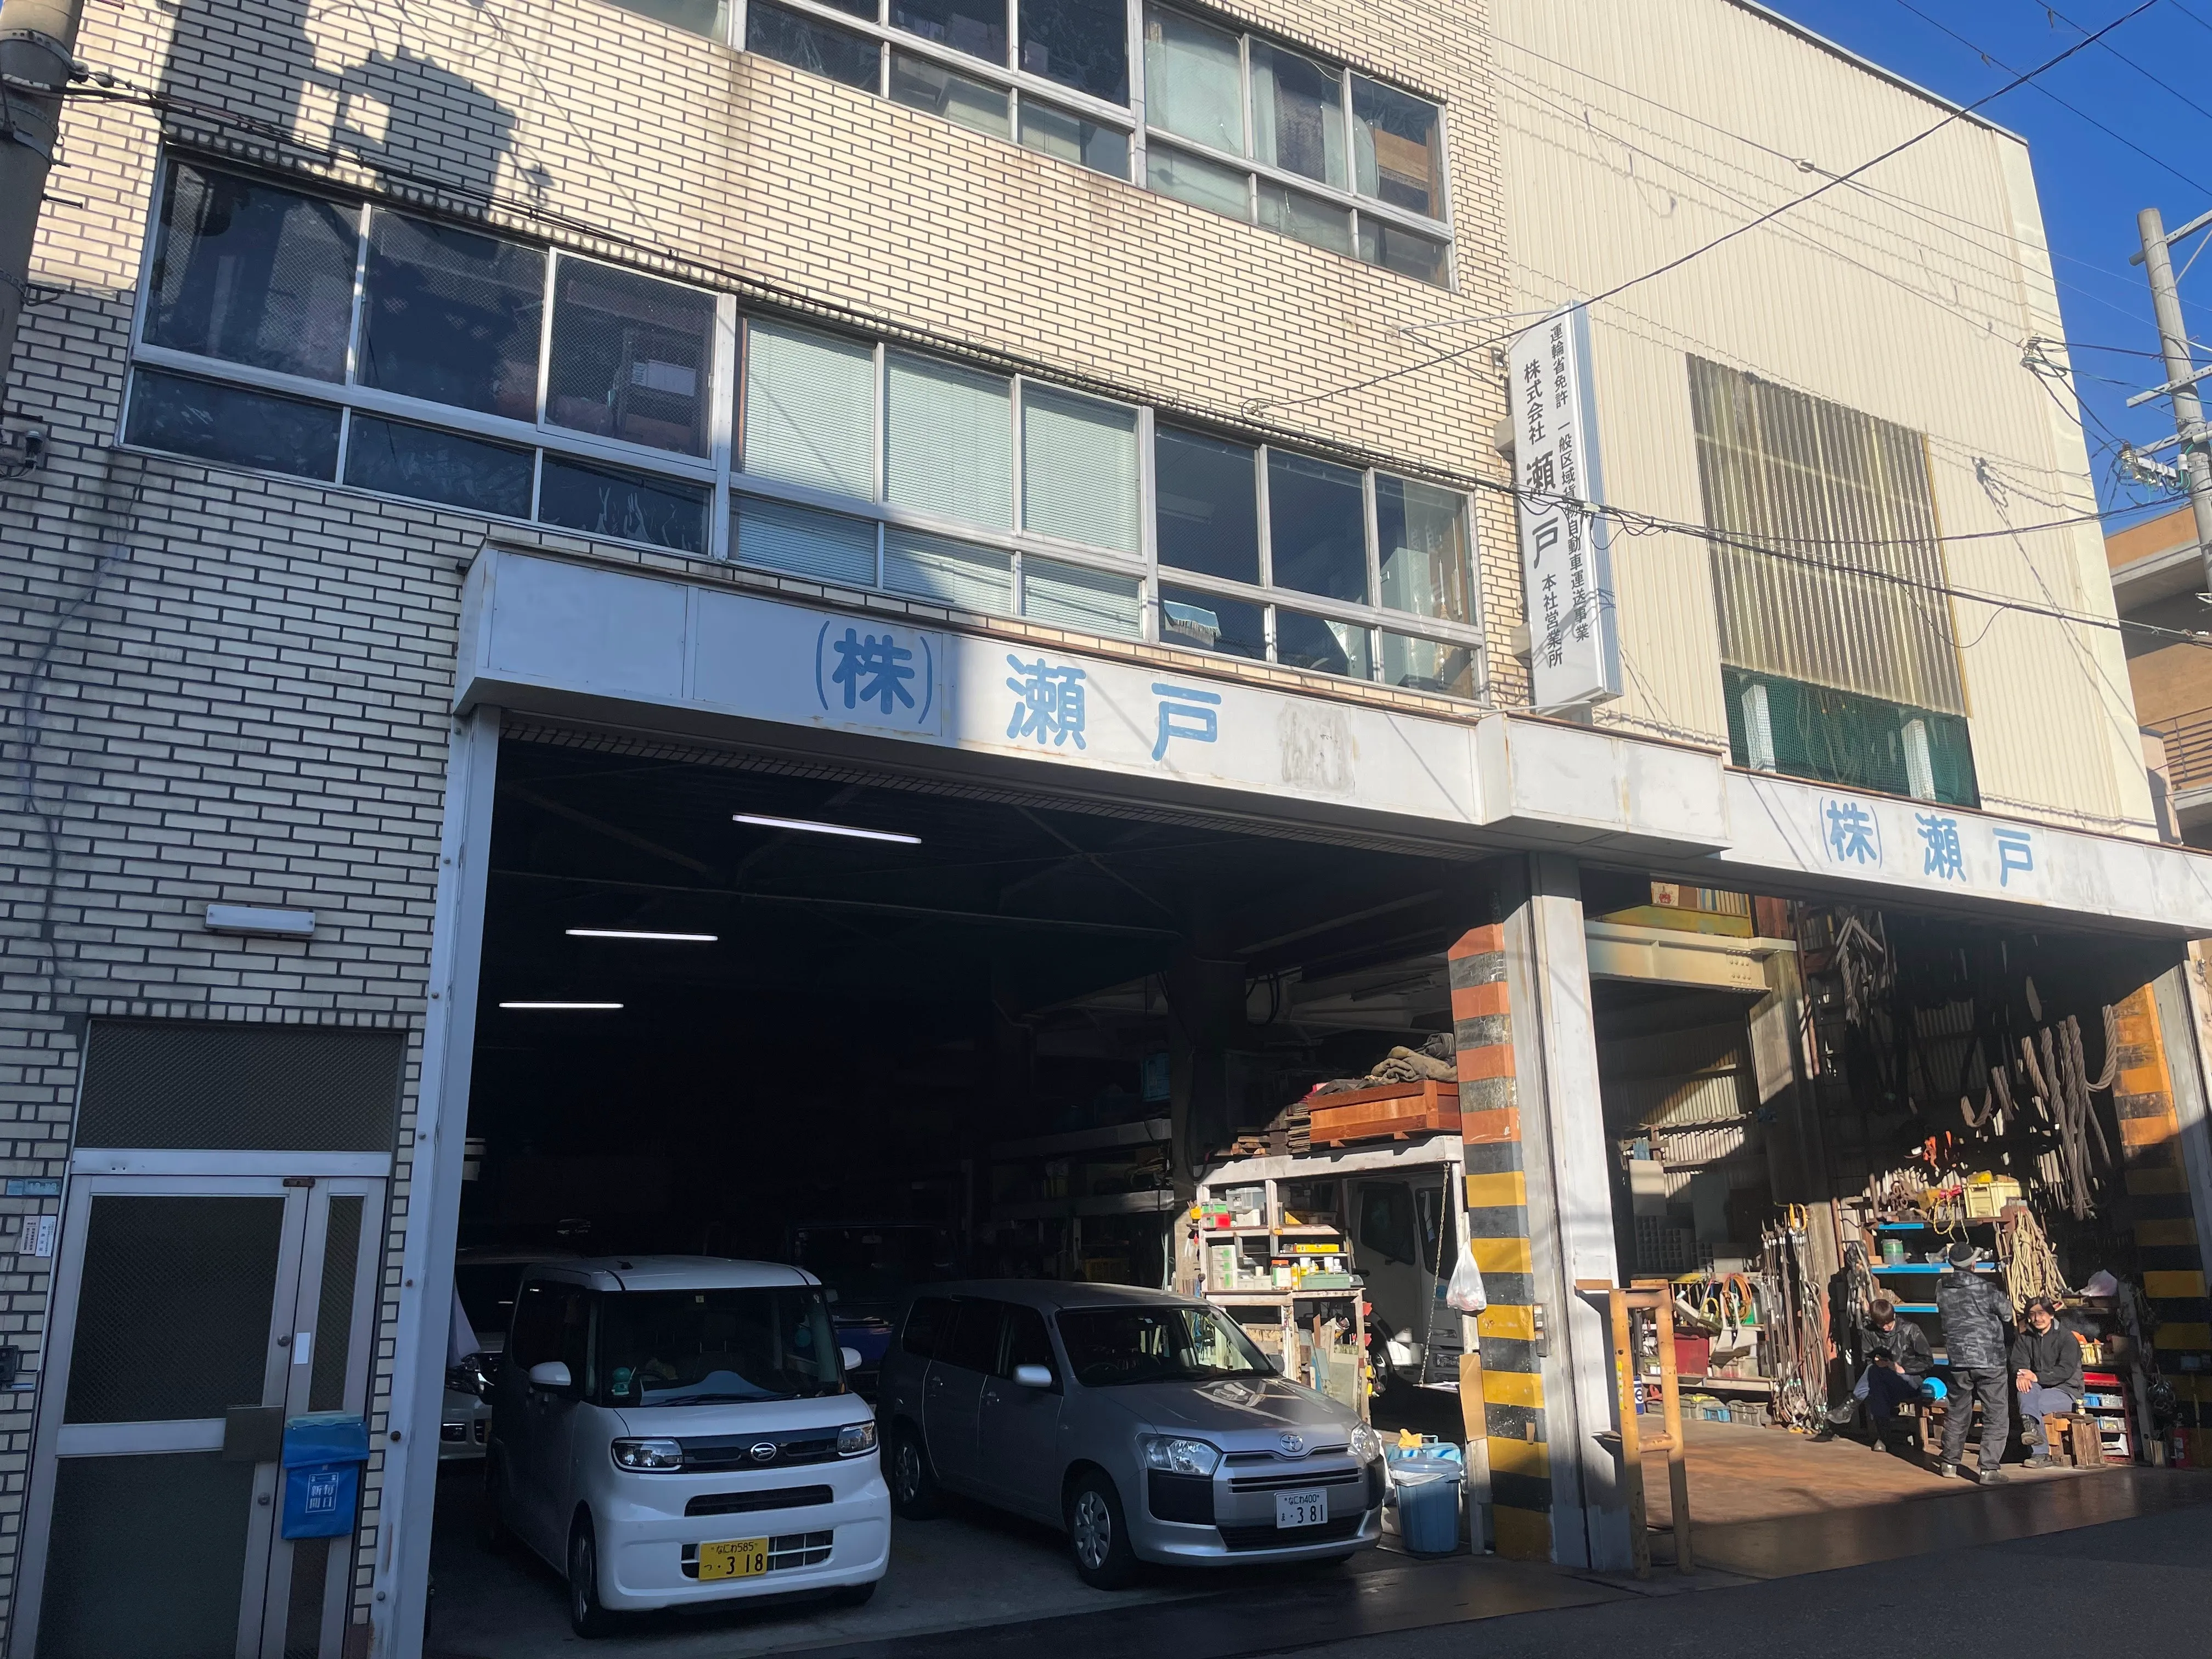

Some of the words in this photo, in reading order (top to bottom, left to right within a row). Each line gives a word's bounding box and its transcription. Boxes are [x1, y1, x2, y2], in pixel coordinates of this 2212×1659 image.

[1523, 358, 1546, 445] 株式会社
[1526, 450, 1559, 569] 瀬戸
[1541, 573, 1564, 668] 本社営業所
